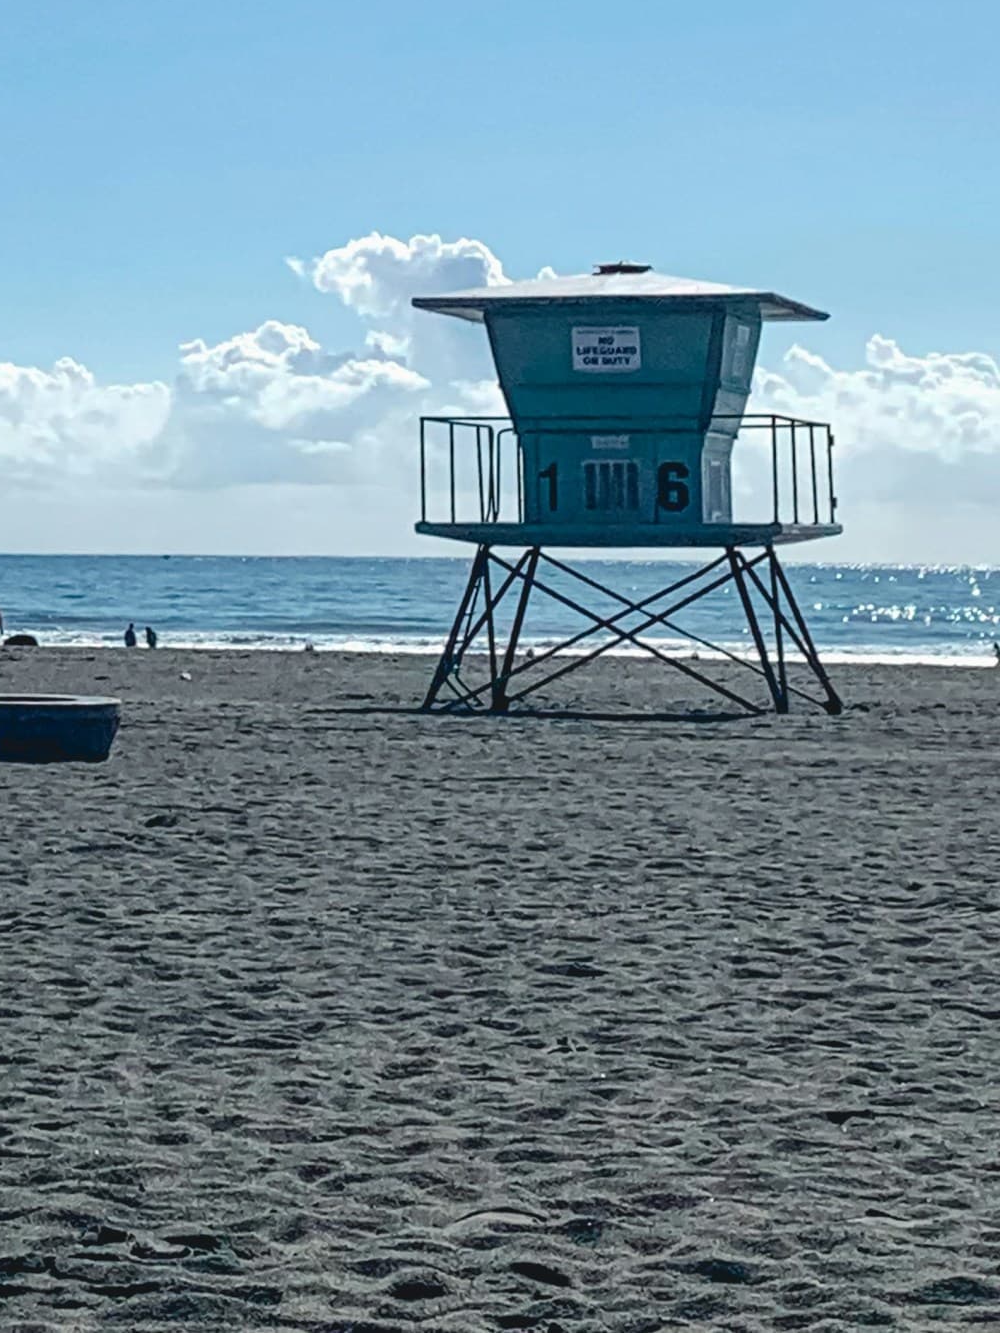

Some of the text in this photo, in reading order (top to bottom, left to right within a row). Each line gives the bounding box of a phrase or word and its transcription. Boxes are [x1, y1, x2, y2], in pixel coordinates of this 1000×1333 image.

[598, 336, 615, 345] NO
[576, 346, 637, 355] LIFEGUARD
[582, 356, 631, 366] ON DUTY
[537, 461, 690, 512] 1 6
